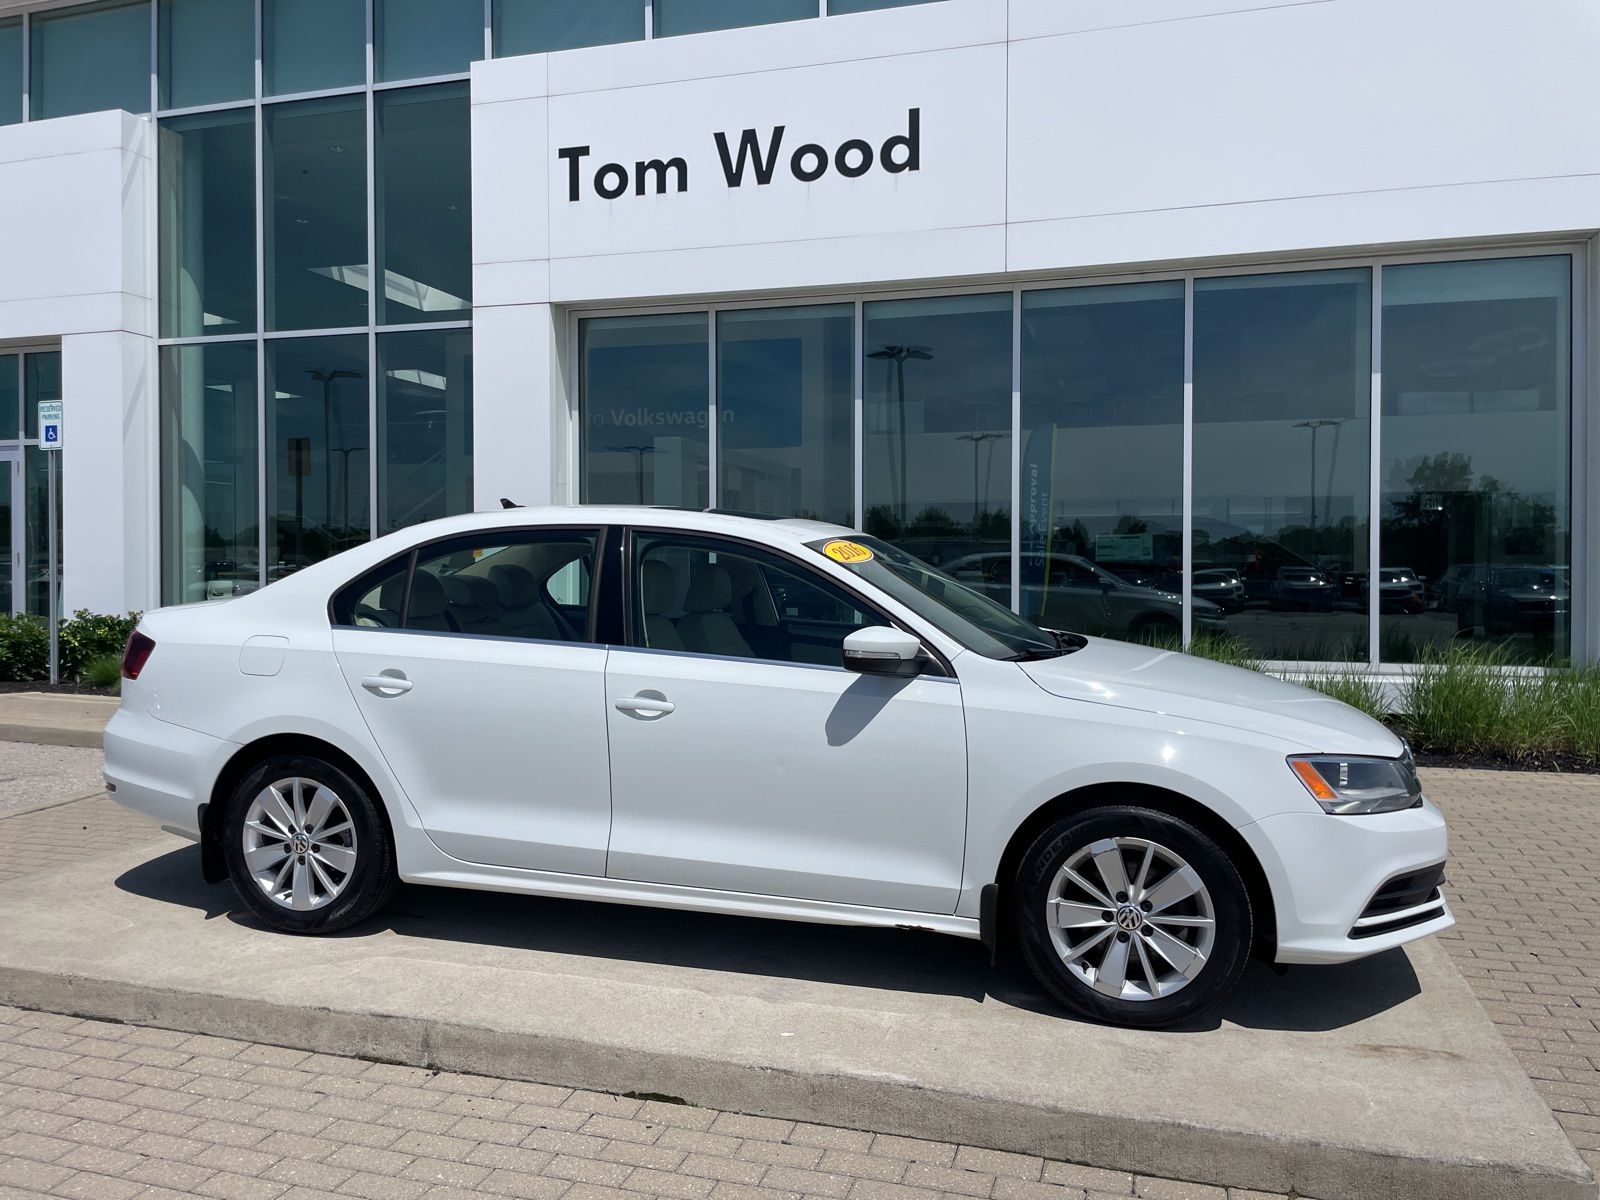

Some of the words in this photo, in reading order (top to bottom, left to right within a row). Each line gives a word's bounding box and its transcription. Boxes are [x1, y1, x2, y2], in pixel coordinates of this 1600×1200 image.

[558, 145, 688, 202] Tom
[713, 107, 920, 188] Wood
[610, 407, 735, 429] Volkswagn
[1039, 488, 1049, 532] Event
[831, 542, 867, 560] 2016
